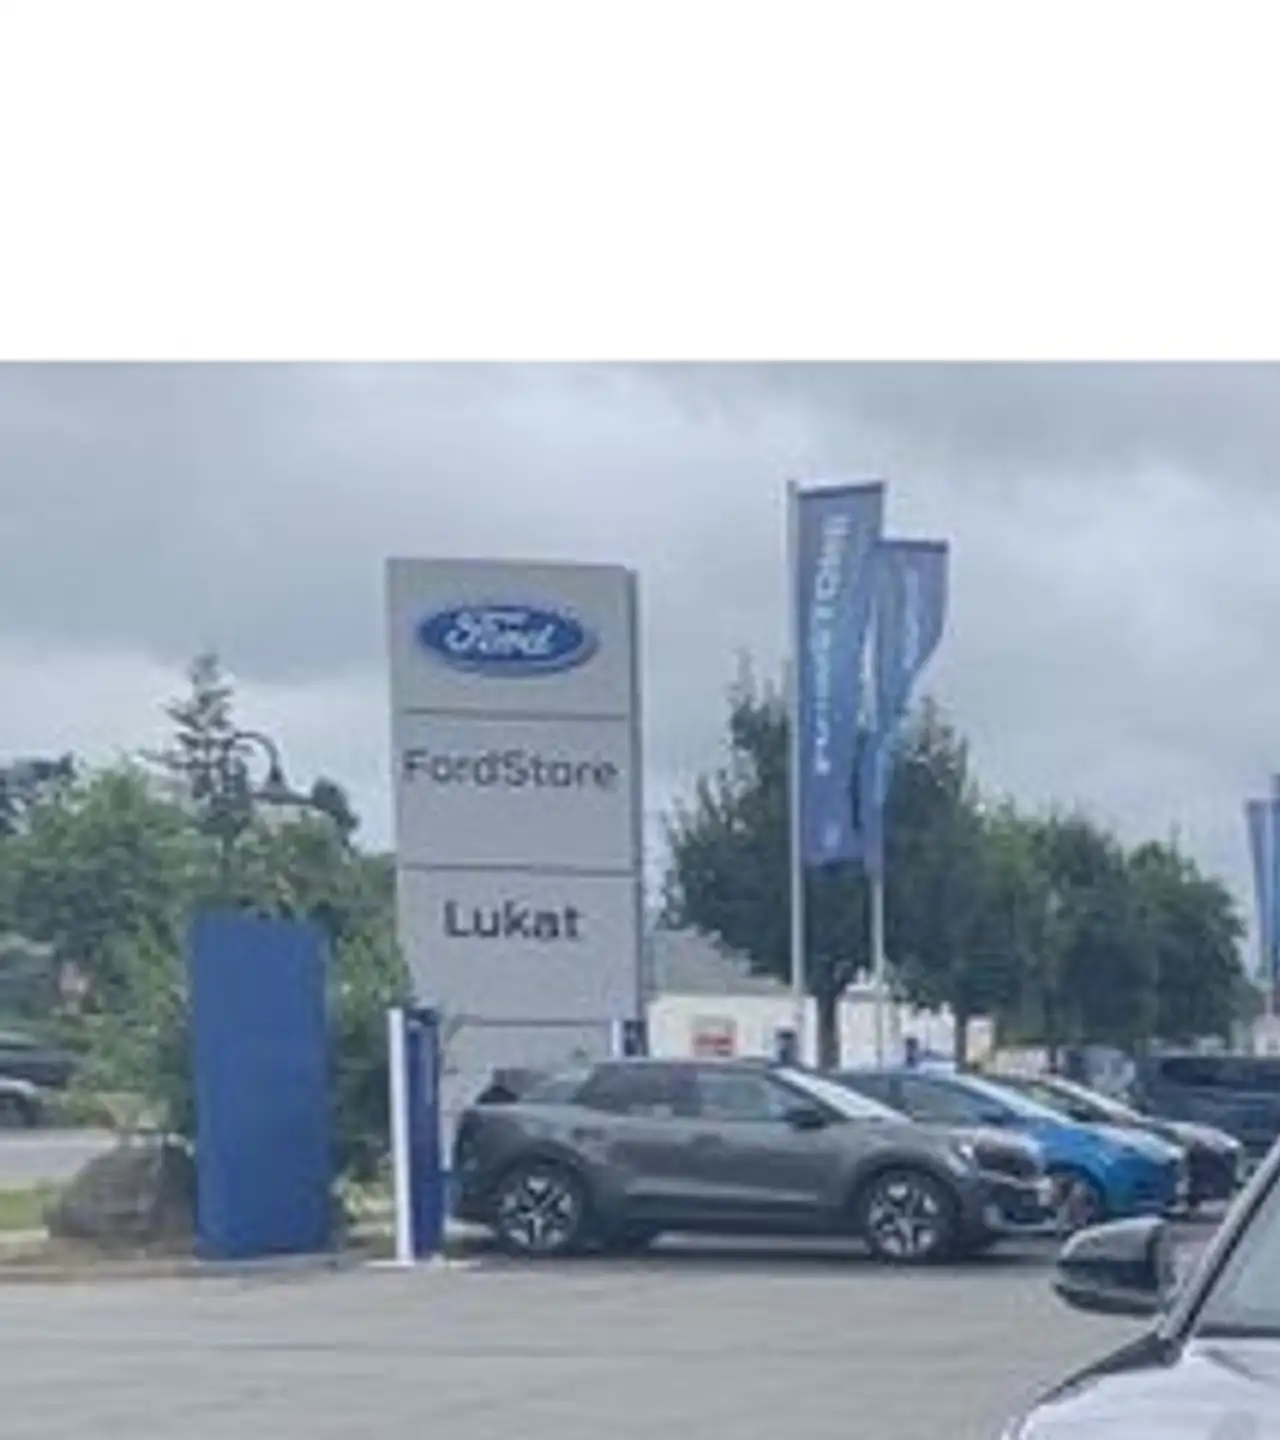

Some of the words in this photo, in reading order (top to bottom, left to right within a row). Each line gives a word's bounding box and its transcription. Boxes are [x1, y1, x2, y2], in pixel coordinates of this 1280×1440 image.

[443, 610, 556, 656] Ford
[402, 749, 619, 788] FordStore
[444, 899, 583, 942] Lukat
